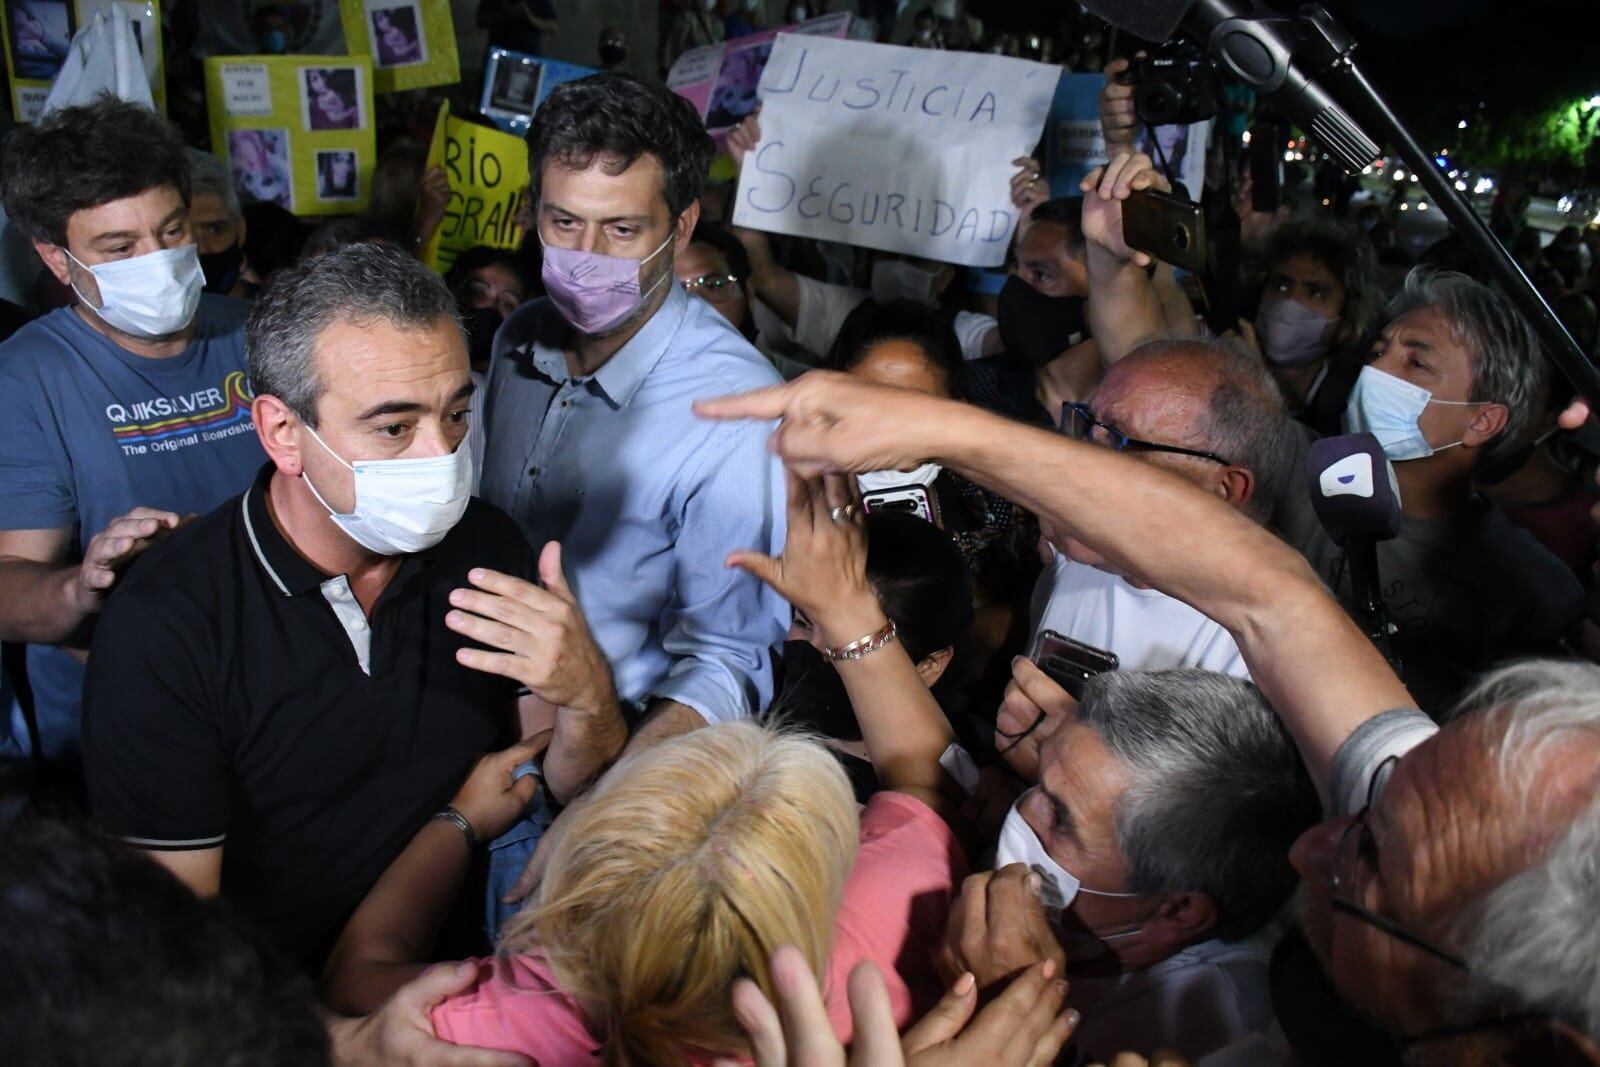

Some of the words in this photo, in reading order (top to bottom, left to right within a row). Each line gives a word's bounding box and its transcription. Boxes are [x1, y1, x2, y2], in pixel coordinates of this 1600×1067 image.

[763, 48, 996, 122] JUSTICIA
[747, 140, 1012, 243] SEGURIDAD
[106, 388, 224, 423] QUIKSILVER
[122, 444, 148, 456] The
[150, 434, 199, 452] Original
[201, 421, 256, 442] Boardsho
